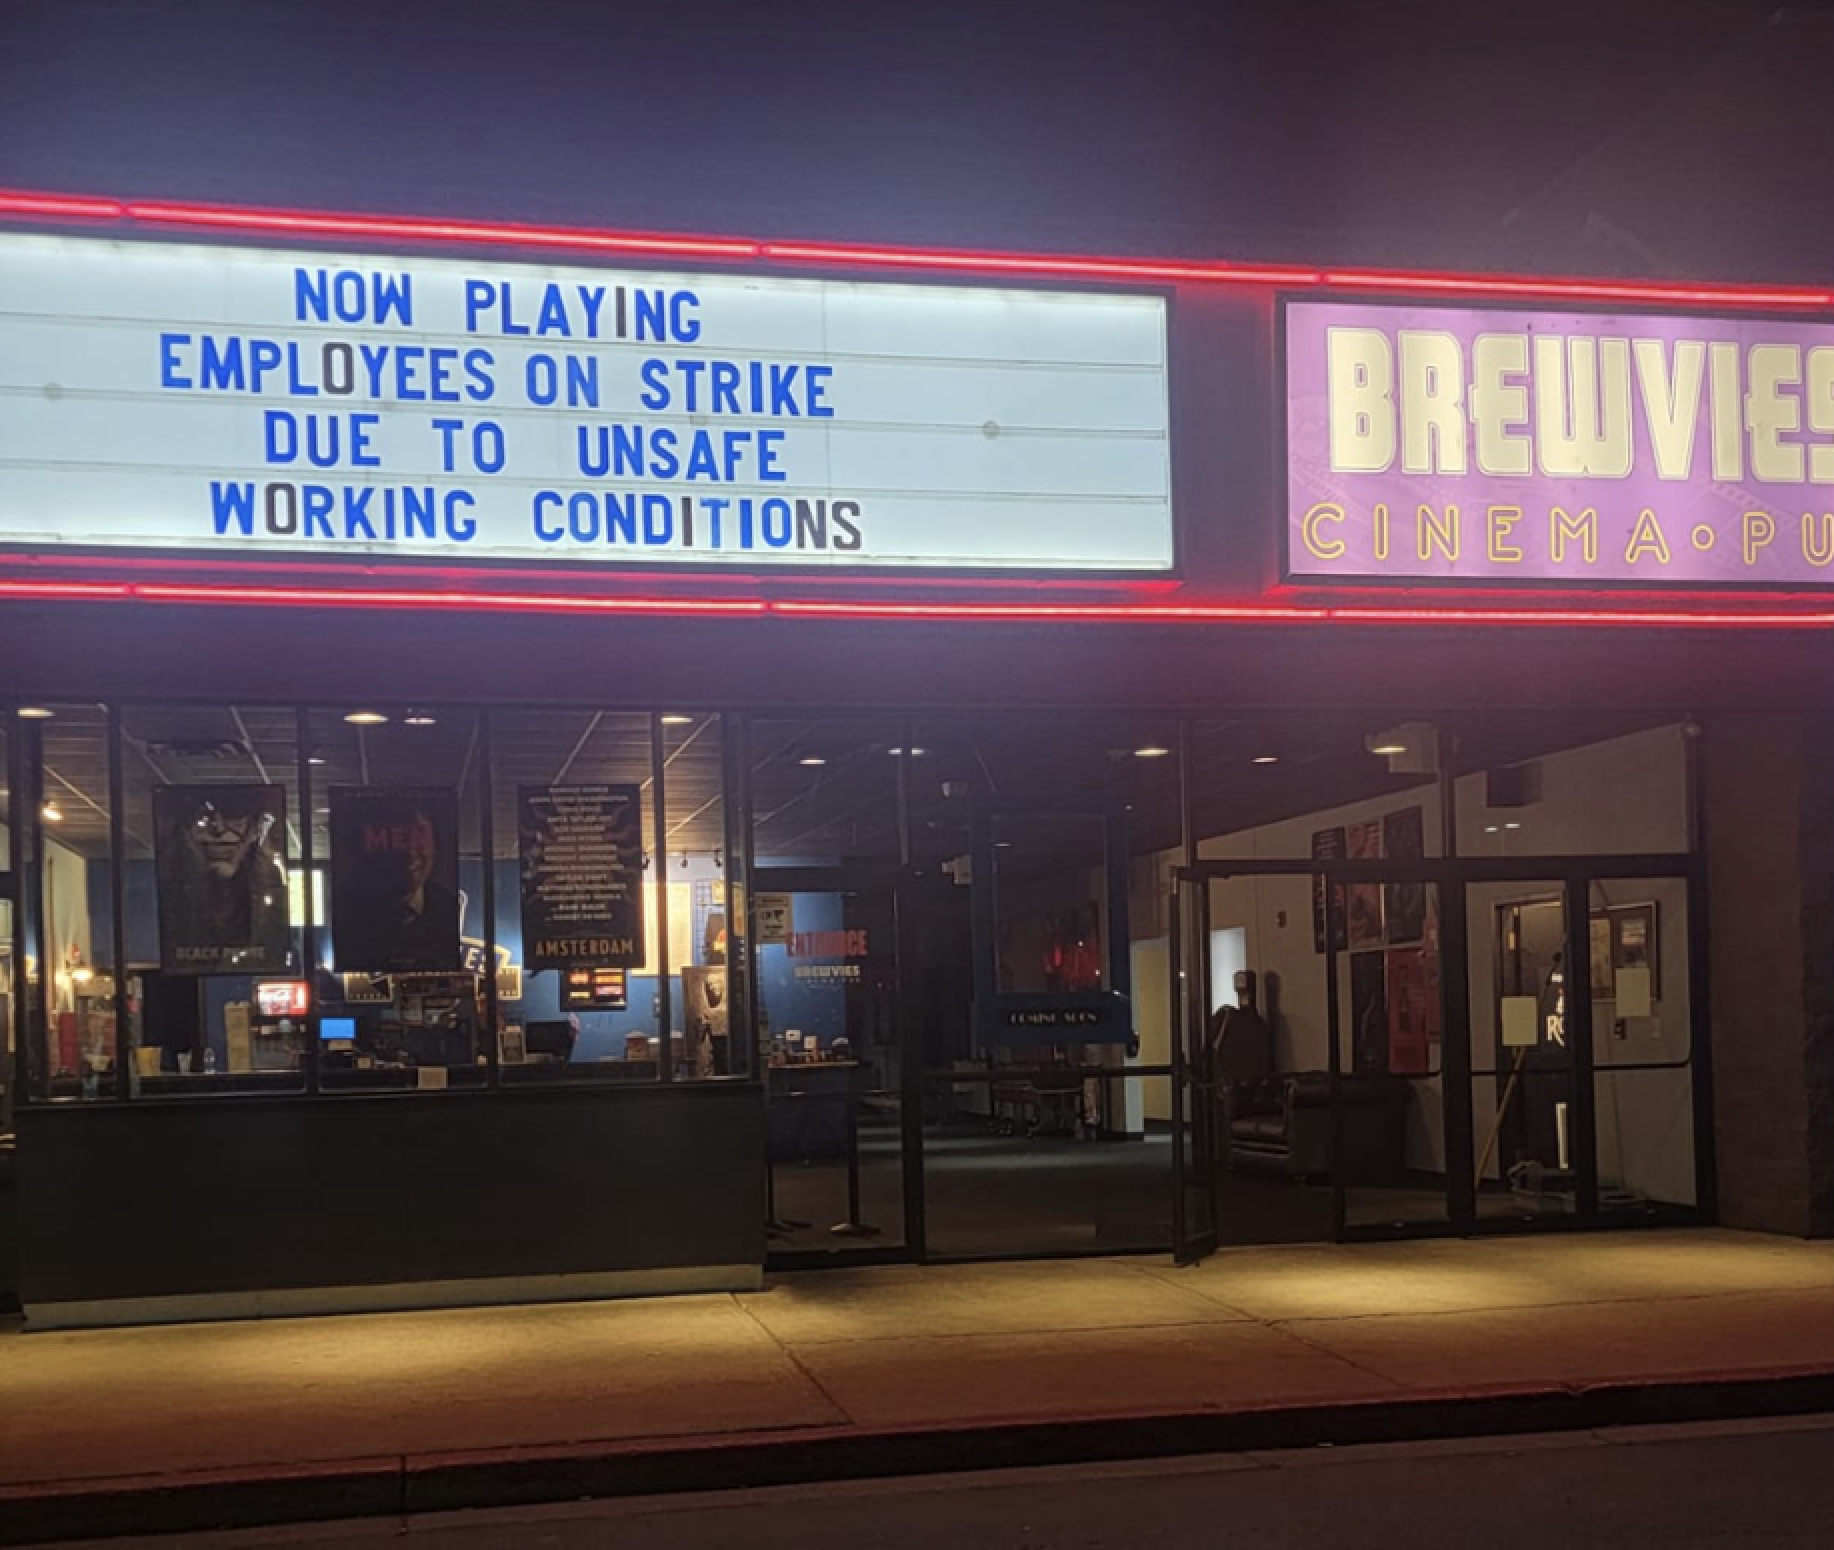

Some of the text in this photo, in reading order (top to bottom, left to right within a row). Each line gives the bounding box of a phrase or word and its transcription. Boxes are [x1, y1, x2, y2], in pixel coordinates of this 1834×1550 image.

[295, 268, 702, 342] NOW PLAYING
[160, 333, 835, 418] EMPLOYEES ON STRIKE
[264, 410, 787, 482] DUE TO UNSAFE
[210, 481, 862, 550] WORKING CONDITIONS
[1302, 501, 1671, 565] CINEMA
[364, 824, 433, 850] MEN
[535, 939, 634, 957] AMSTERDAM
